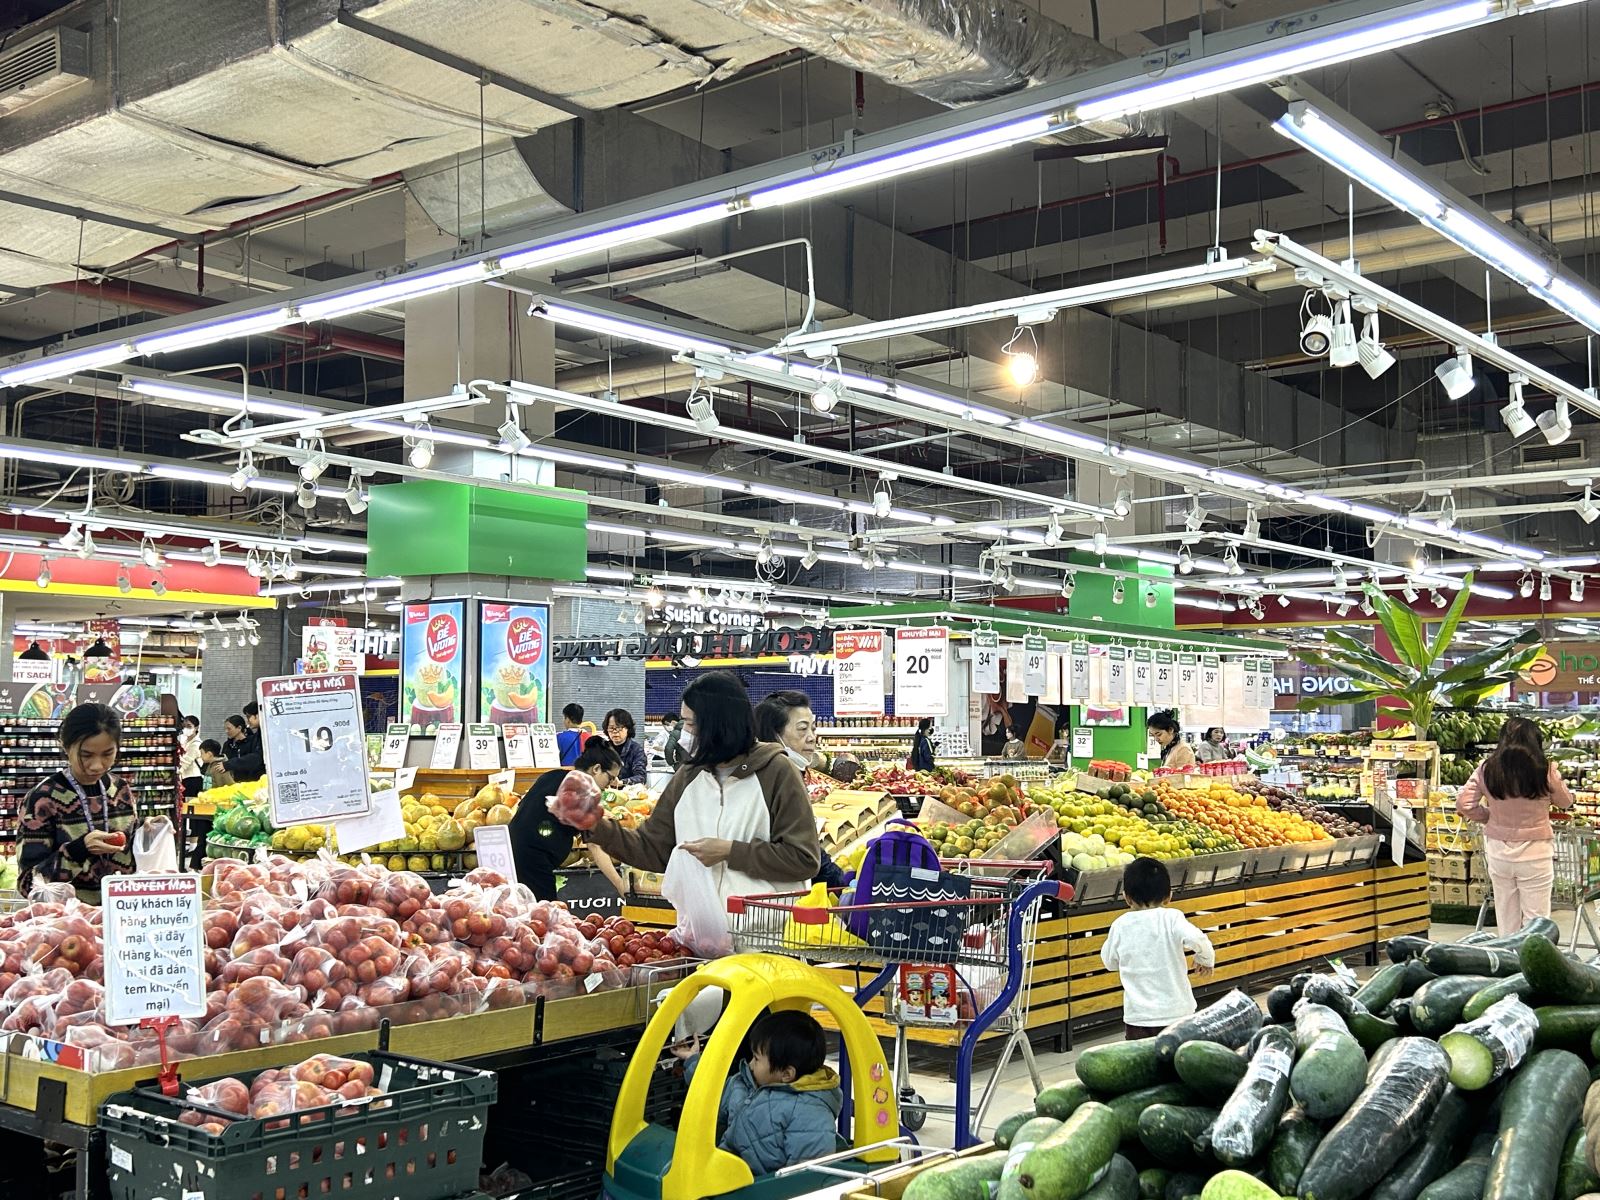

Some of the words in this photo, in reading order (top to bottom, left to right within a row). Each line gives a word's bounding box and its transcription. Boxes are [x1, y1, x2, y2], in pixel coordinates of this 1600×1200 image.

[665, 605, 704, 624] Sushi
[709, 608, 757, 627] Corner
[906, 655, 929, 674] 20
[978, 652, 990, 666] 34
[1029, 656, 1039, 669] 49
[839, 662, 854, 672] 220
[1075, 660, 1084, 672] 58
[1112, 664, 1120, 677] 59
[1137, 667, 1146, 678] 62
[1159, 669, 1168, 680] 25
[1182, 670, 1191, 681] 59
[1205, 672, 1214, 683] 39
[840, 686, 855, 695] 196
[390, 739, 400, 749] 49
[475, 739, 488, 750] 39
[508, 739, 518, 749] 47
[538, 739, 550, 749] 82
[116, 899, 139, 911] Quý
[141, 898, 173, 909] khách
[176, 896, 191, 909] lấy
[568, 897, 611, 909] TƯƠI
[150, 912, 189, 926] khuyến
[126, 933, 146, 944] mại
[165, 932, 185, 943] đây
[118, 949, 151, 961] (Hàng
[150, 965, 164, 976] đã
[166, 963, 187, 975] dán
[125, 985, 147, 995] tem
[146, 998, 170, 1011] mại)
